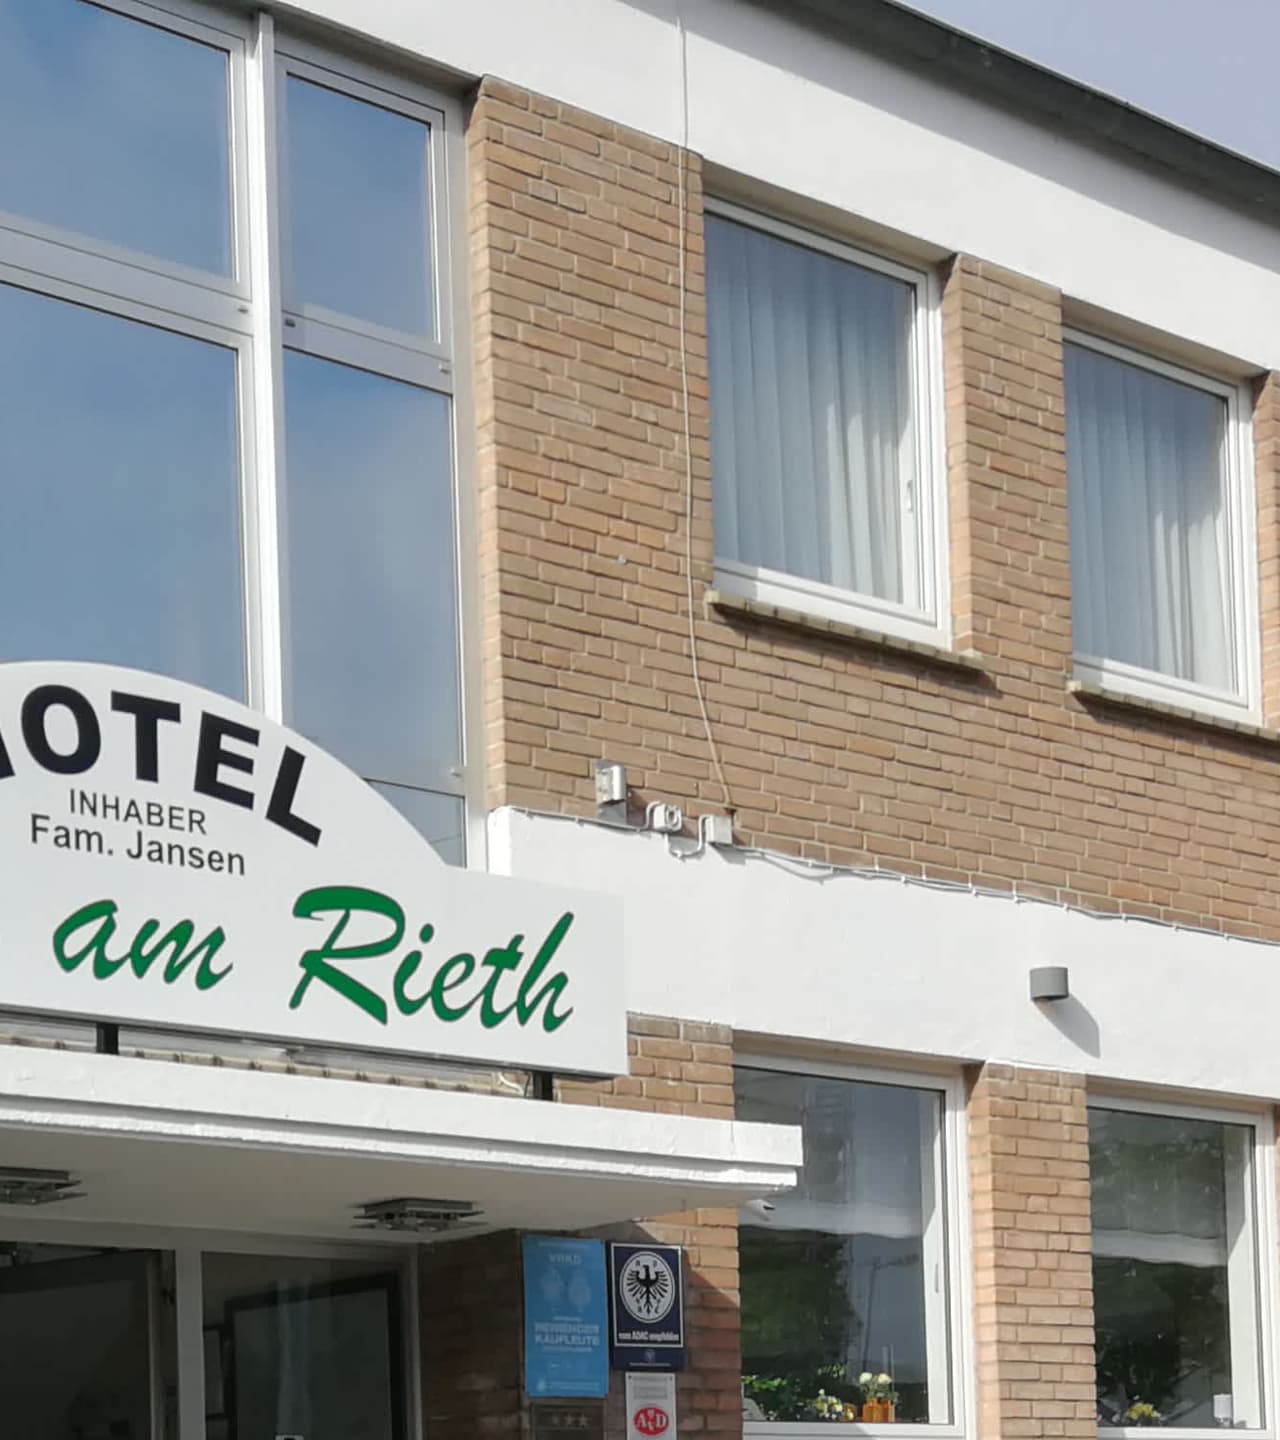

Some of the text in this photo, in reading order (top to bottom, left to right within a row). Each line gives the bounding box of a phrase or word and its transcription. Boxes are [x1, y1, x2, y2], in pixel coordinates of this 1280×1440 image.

[70, 788, 207, 835] INHABER
[31, 813, 245, 876] Fam. Jansen
[52, 899, 233, 992] am
[289, 885, 574, 1034] Rieth
